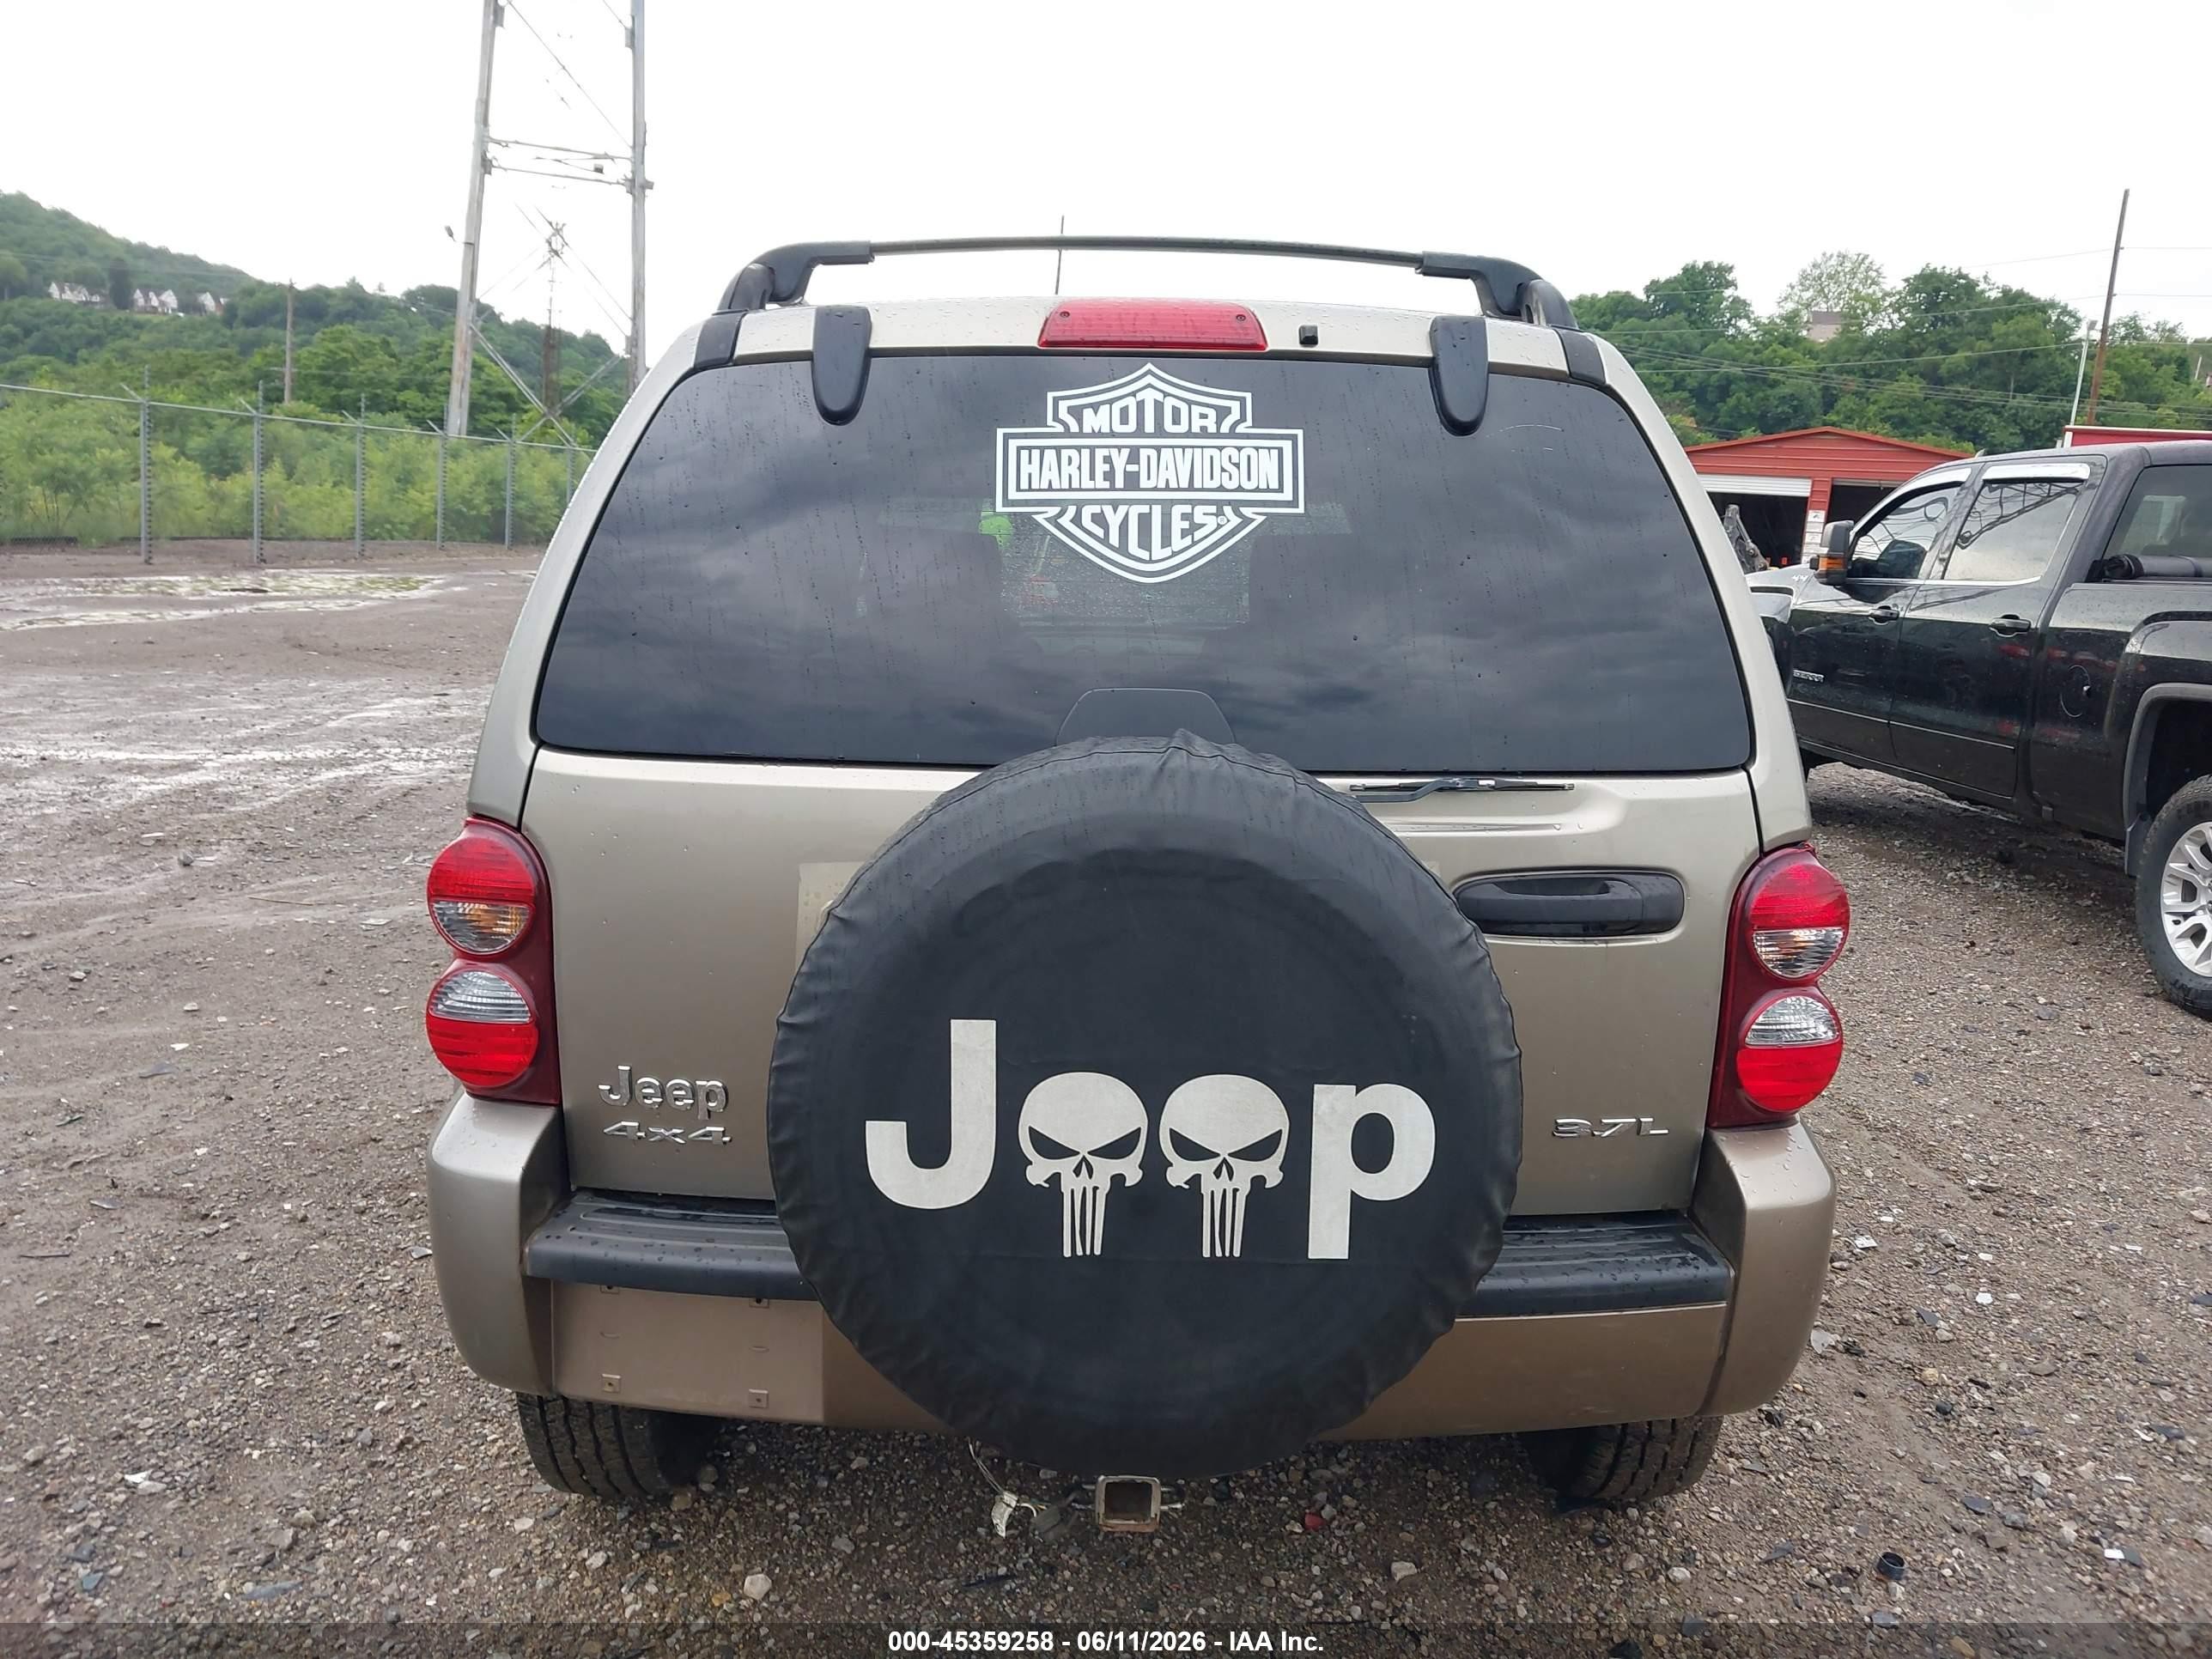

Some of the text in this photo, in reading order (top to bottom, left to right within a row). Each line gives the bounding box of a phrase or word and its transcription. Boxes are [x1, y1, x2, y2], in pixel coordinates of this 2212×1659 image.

[1082, 387, 1218, 434] MOTOR
[1019, 447, 1279, 490] HARLEY-DAVIDSON
[1081, 504, 1218, 561] CYCLES
[598, 1065, 729, 1121] Jeep
[603, 1121, 732, 1146] 4x4
[1553, 1117, 1670, 1139] 3.7L
